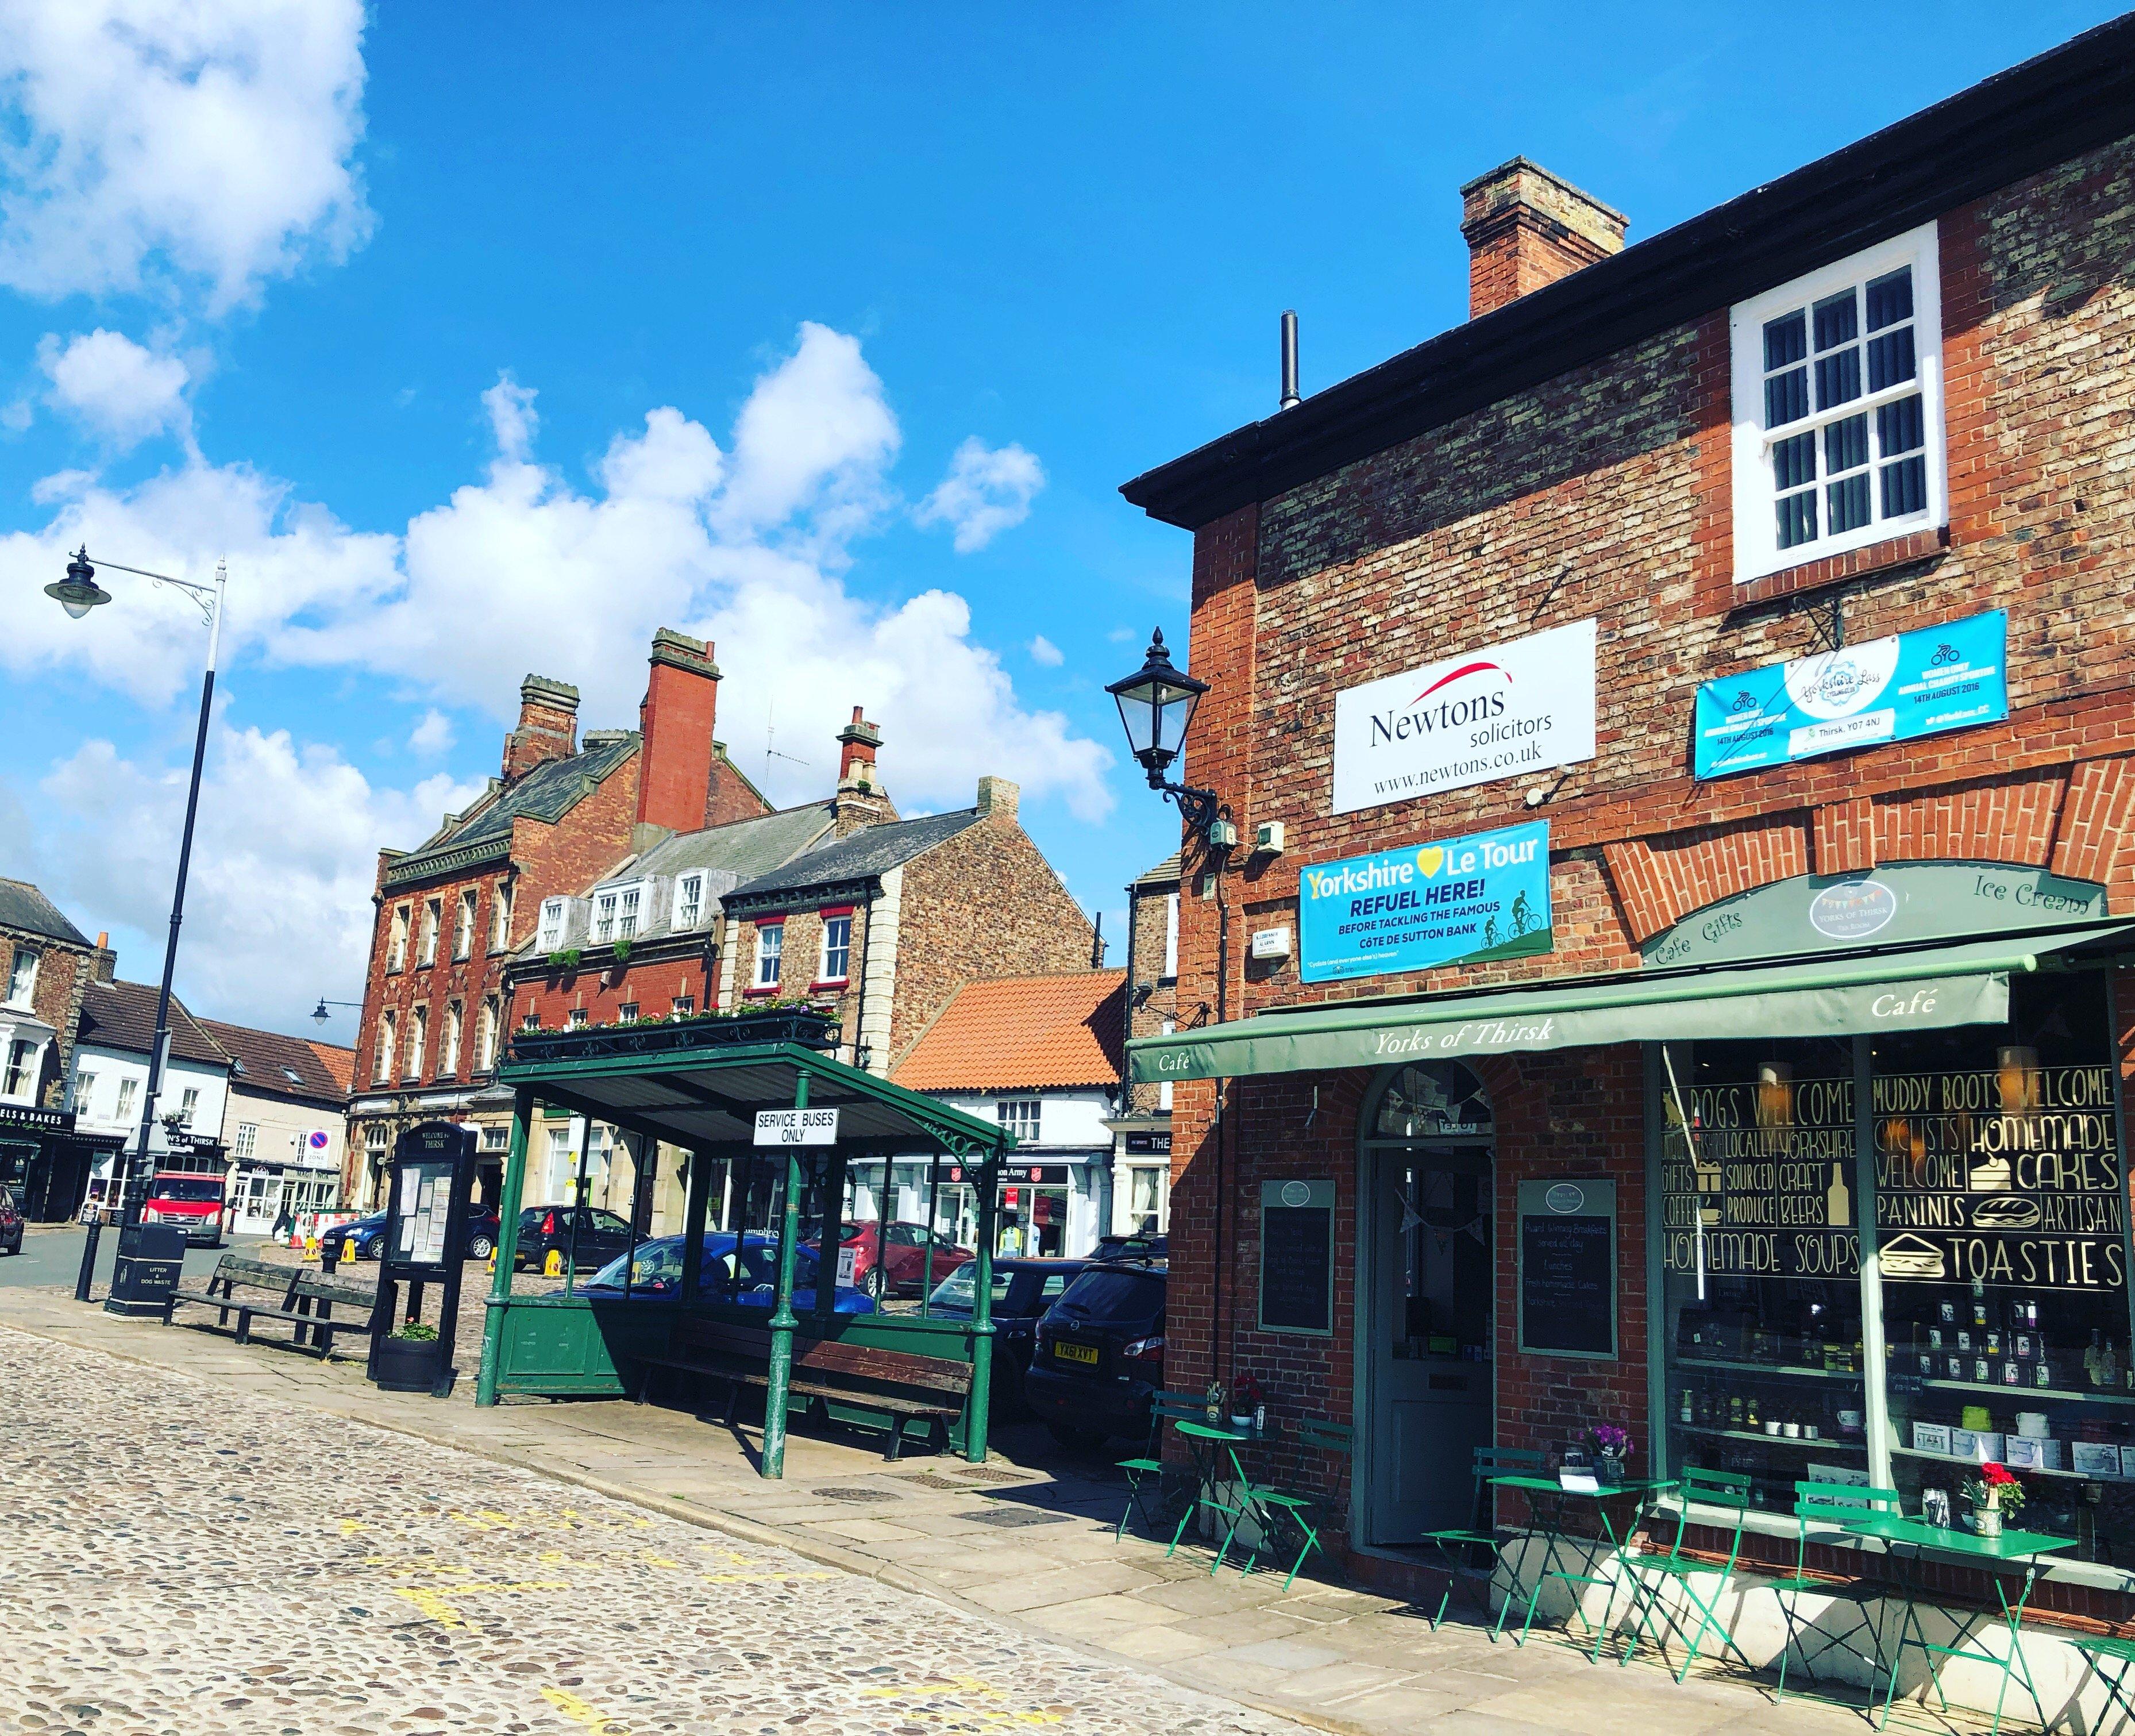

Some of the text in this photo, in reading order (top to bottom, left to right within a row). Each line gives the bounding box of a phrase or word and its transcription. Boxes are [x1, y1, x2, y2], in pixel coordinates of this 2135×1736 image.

[1857, 669, 1880, 685] Lass
[1914, 683, 1979, 704] 14TH AUGUST 2016
[1369, 691, 1505, 748] Newtons
[1470, 714, 1552, 748] solicitors
[1848, 721, 1863, 731] YO7
[1866, 718, 1880, 726] 4NJ
[1717, 727, 1774, 745] 14TH AUGUST 2016
[1374, 741, 1543, 795] www.newtons.co.uk
[1308, 837, 1538, 900] Yorkshire Le Tour
[1350, 878, 1486, 918] REFUEL HERE!
[1974, 875, 2089, 915] Ice Cream
[1338, 900, 1500, 935] BEFORE TACKLING THE FAMOUS
[1818, 913, 1844, 923] YORKS
[1859, 907, 1888, 918] THIRSK
[1386, 933, 1400, 946] DE
[1402, 927, 1444, 943] SUTTON
[1447, 923, 1477, 938] BANK
[1655, 910, 1743, 965] Cafe Gifts
[1871, 988, 1939, 1018] Café
[1374, 1018, 1555, 1055] Yorks of Thirsk
[1158, 1053, 1190, 1072] Café
[1691, 1081, 1855, 1129] DOGS WELCOME
[1873, 1076, 1931, 1112] MUDDY
[1943, 1073, 2003, 1110] BOOTS
[20, 1112, 25, 1120] &
[29, 1113, 61, 1125] BAKES
[758, 1113, 834, 1127] SERVICE BUSES
[190, 1135, 214, 1146] THIRSK
[425, 1140, 445, 1148] THIRSK
[782, 1129, 805, 1142] ONLY
[1151, 1137, 1170, 1149] THE
[1725, 1131, 1776, 1158] LOCALLY
[1779, 1130, 1856, 1159] YORKSHIRE
[1874, 1117, 1960, 1152] CYCLISTS
[1971, 1114, 2116, 1153] HOMEMADE
[297, 1171, 312, 1179] MAGI
[1009, 1168, 1027, 1177] Army
[1662, 1164, 1692, 1192] GIFTS
[1727, 1163, 1774, 1191] SOURCED
[1779, 1163, 1826, 1192] CRAFT
[1874, 1153, 1963, 1188] WELCOME
[2017, 1153, 2118, 1190] CAKES
[1663, 1196, 1696, 1225] COFFEE
[1727, 1196, 1775, 1223] PRODUCE
[1780, 1196, 1824, 1225] BEERS
[1877, 1195, 1965, 1227] PANINIS
[2045, 1196, 2122, 1233] ARTISAN
[1525, 1222, 1545, 1233] Award
[1573, 1223, 1608, 1236] Breakfasts
[1570, 1238, 1584, 1253] day
[1664, 1232, 1860, 1274] HOMEMADE SOUPS
[1544, 1258, 1573, 1271] Lunches
[1946, 1237, 2123, 1287] TOASTIES
